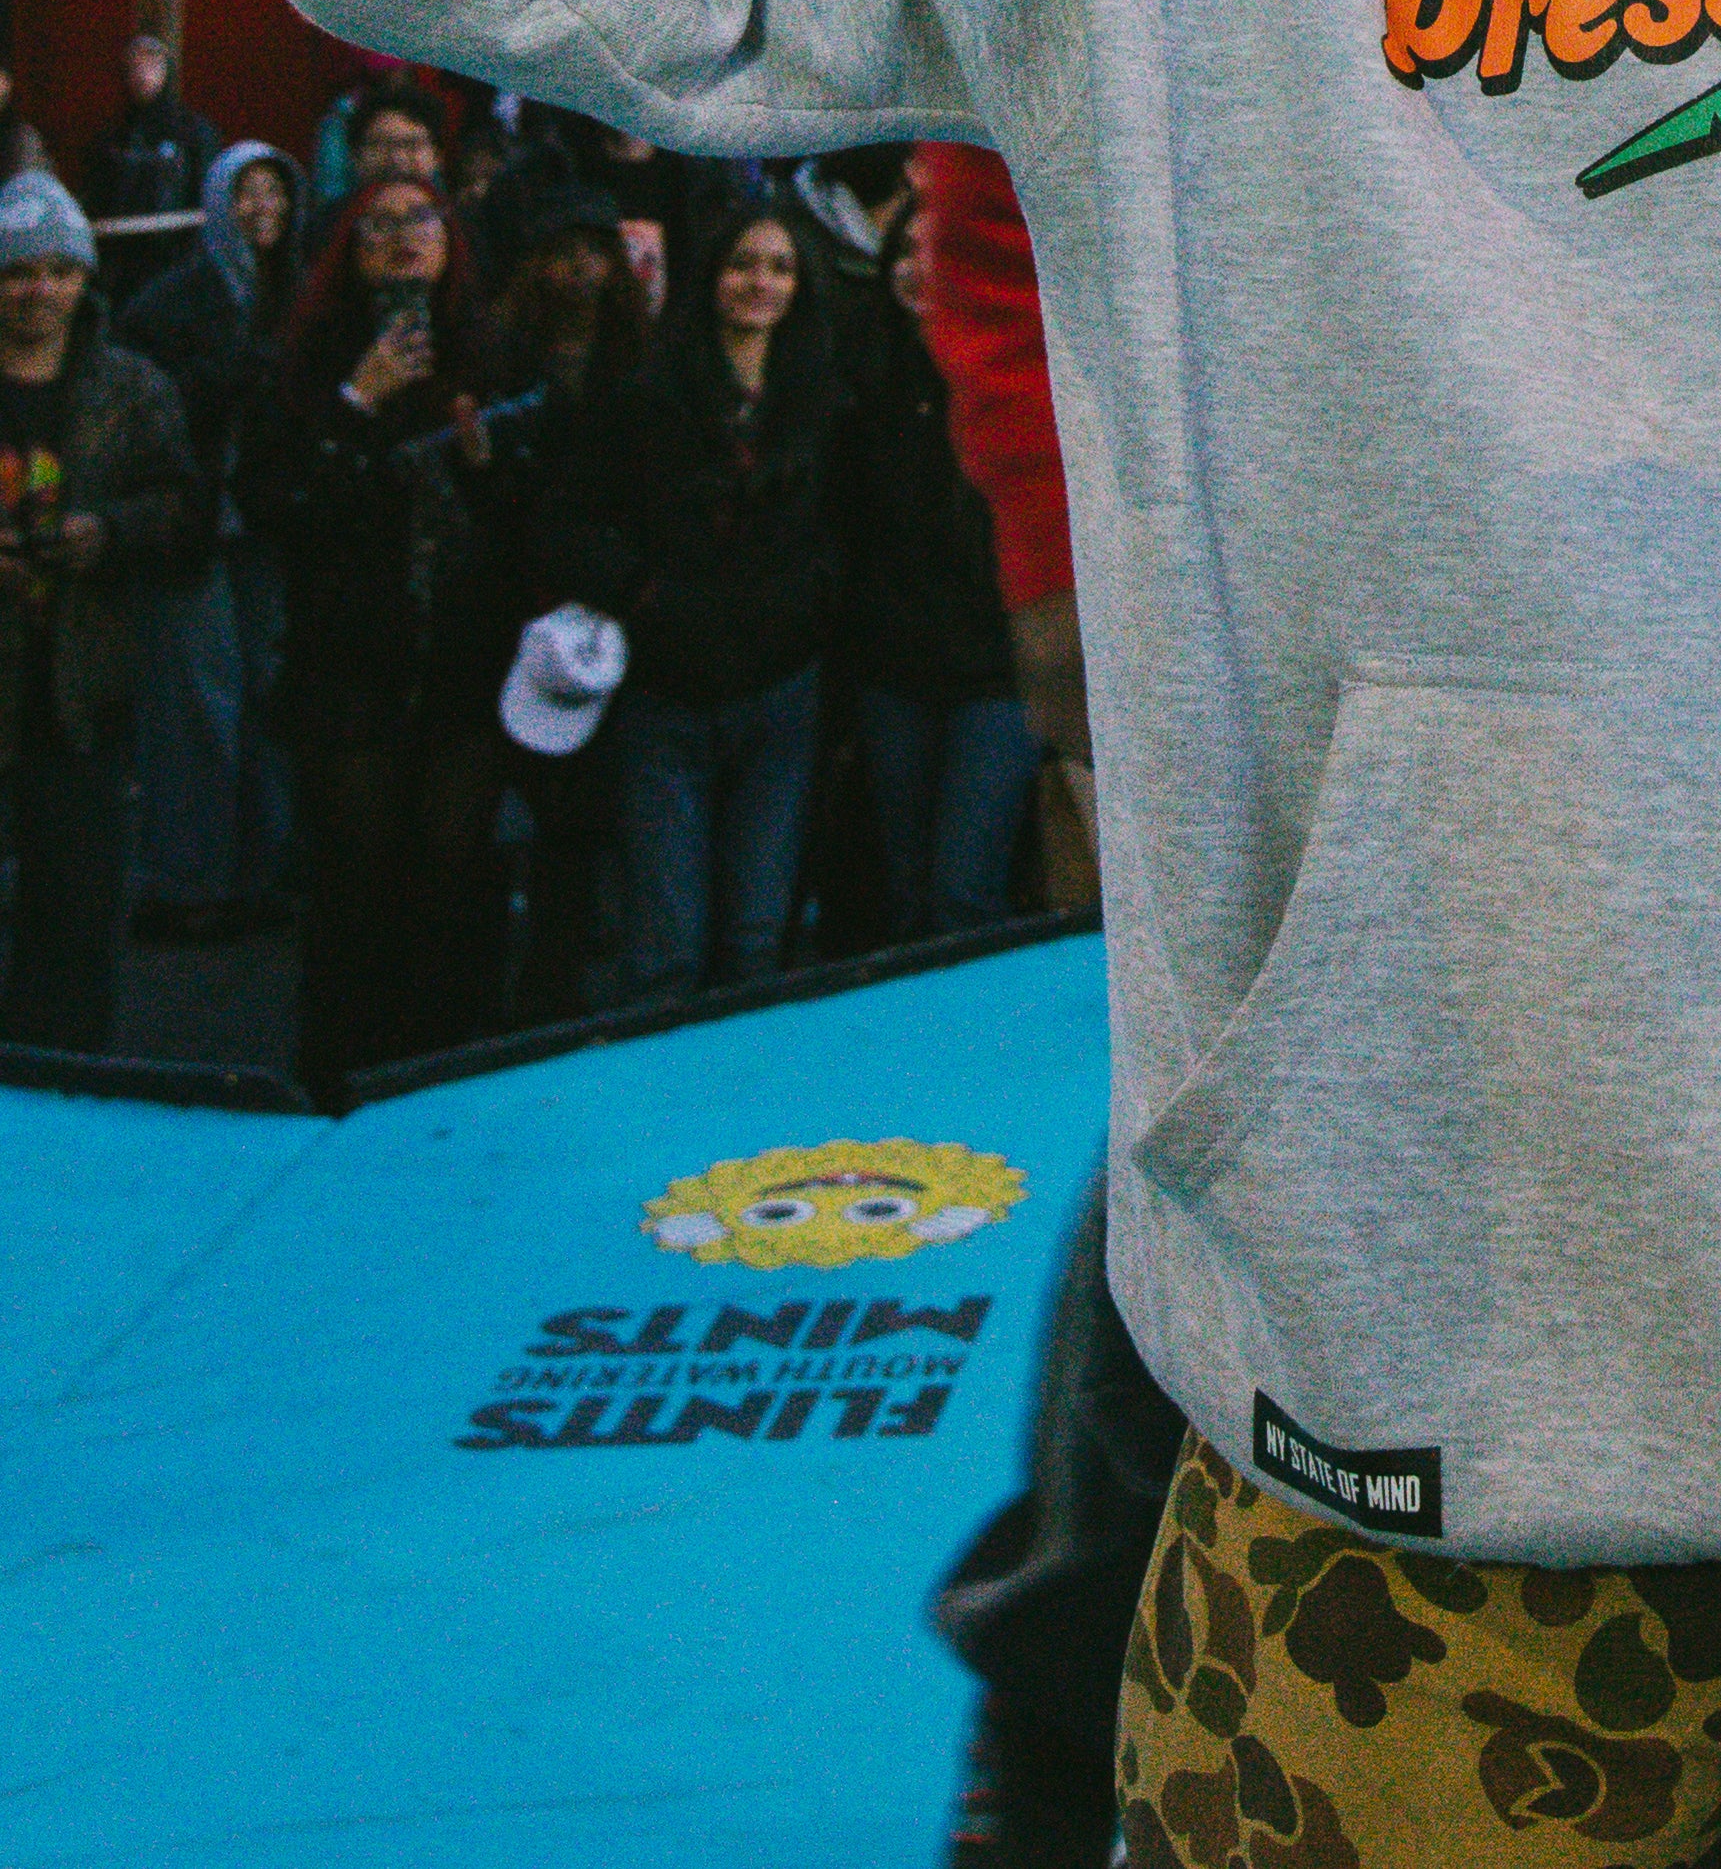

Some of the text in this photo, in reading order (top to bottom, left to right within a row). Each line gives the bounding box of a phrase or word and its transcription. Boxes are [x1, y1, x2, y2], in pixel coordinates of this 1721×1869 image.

[525, 1294, 993, 1358] MINTS
[493, 1354, 967, 1392] MOUTH WATERING
[1266, 1420, 1421, 1513] NY STATE OF MIND
